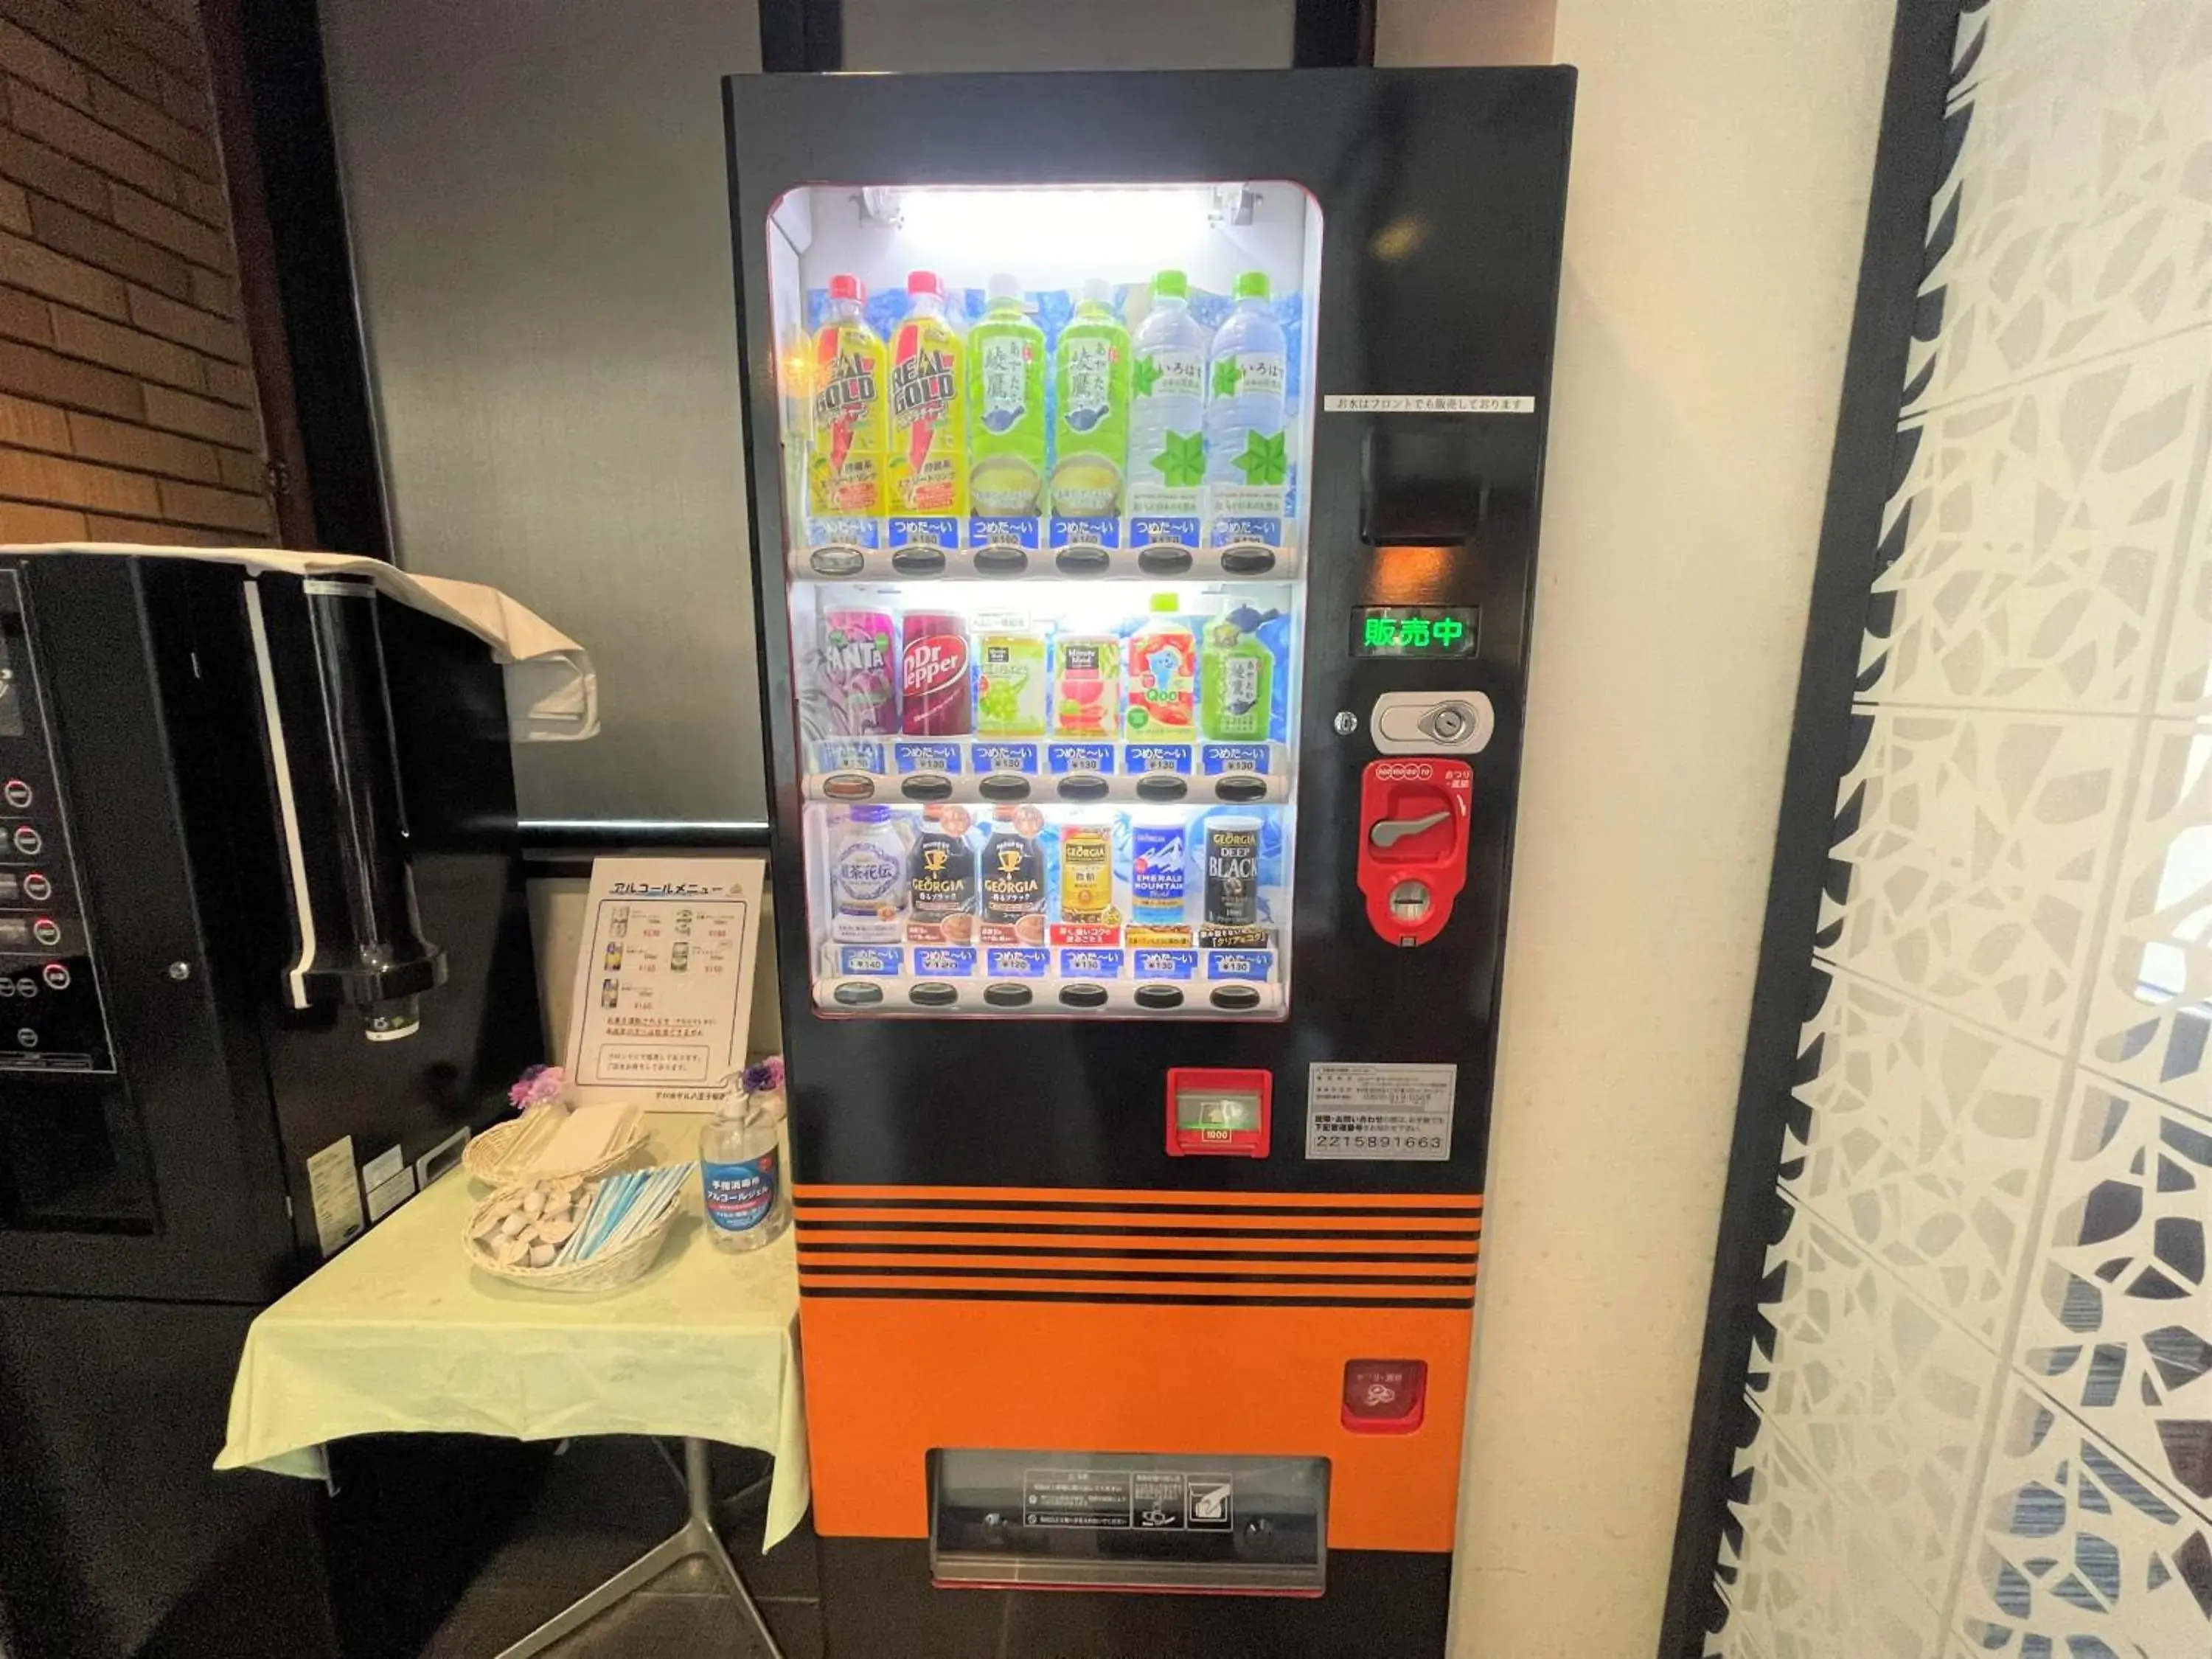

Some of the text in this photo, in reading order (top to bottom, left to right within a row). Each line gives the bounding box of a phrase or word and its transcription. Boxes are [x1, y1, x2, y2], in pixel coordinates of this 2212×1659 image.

[895, 373, 956, 416] GOLD
[1337, 398, 1521, 410] お水はフロントでも販売しております
[1364, 617, 1464, 647] 販売中
[915, 646, 941, 668] Dr
[904, 655, 959, 689] Pepper
[1147, 689, 1177, 702] Qoo
[1071, 760, 1097, 770] ¥130
[1150, 760, 1175, 770] ¥130
[1221, 847, 1251, 857] DEEP
[613, 882, 724, 894] アルコールメニュー
[912, 876, 965, 892] GEORGIA
[984, 877, 1039, 894] GEORGIA
[1147, 961, 1173, 970] ¥130
[1222, 962, 1248, 972] ¥130
[1316, 1135, 1441, 1149] 2215891663
[708, 1186, 769, 1203] アルコールジェル
